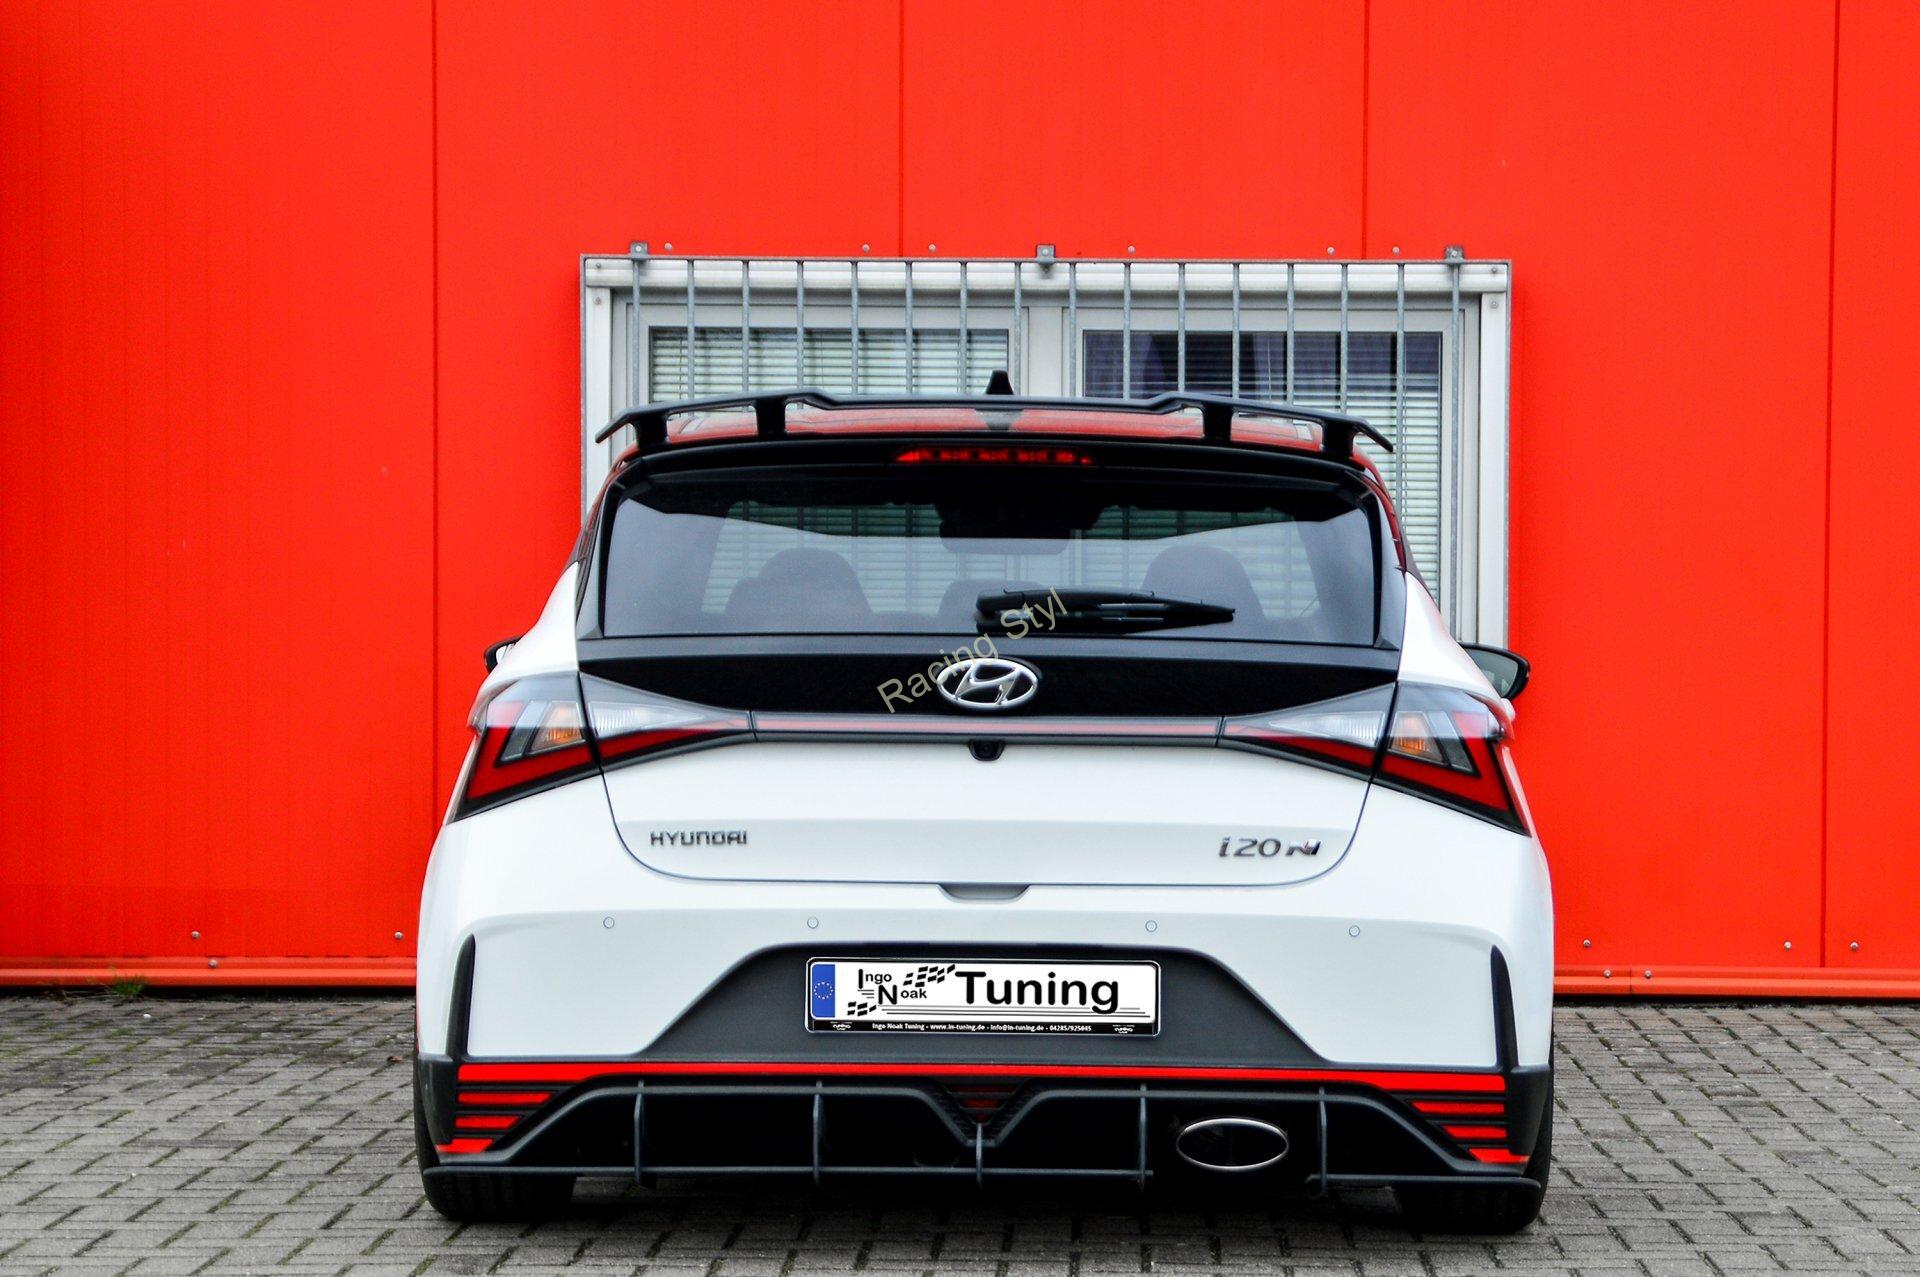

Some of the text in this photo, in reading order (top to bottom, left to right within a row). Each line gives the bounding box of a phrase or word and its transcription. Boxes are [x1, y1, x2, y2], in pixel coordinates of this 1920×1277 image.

[650, 830, 747, 846] HYUNDAI
[1219, 836, 1281, 857] i20
[858, 968, 892, 989] Ingo
[878, 984, 927, 1005] Noak
[954, 971, 1119, 1014] Tuning
[872, 1022, 886, 1030] Ingo
[887, 1022, 903, 1030] Noak
[905, 1023, 925, 1031] Tuning
